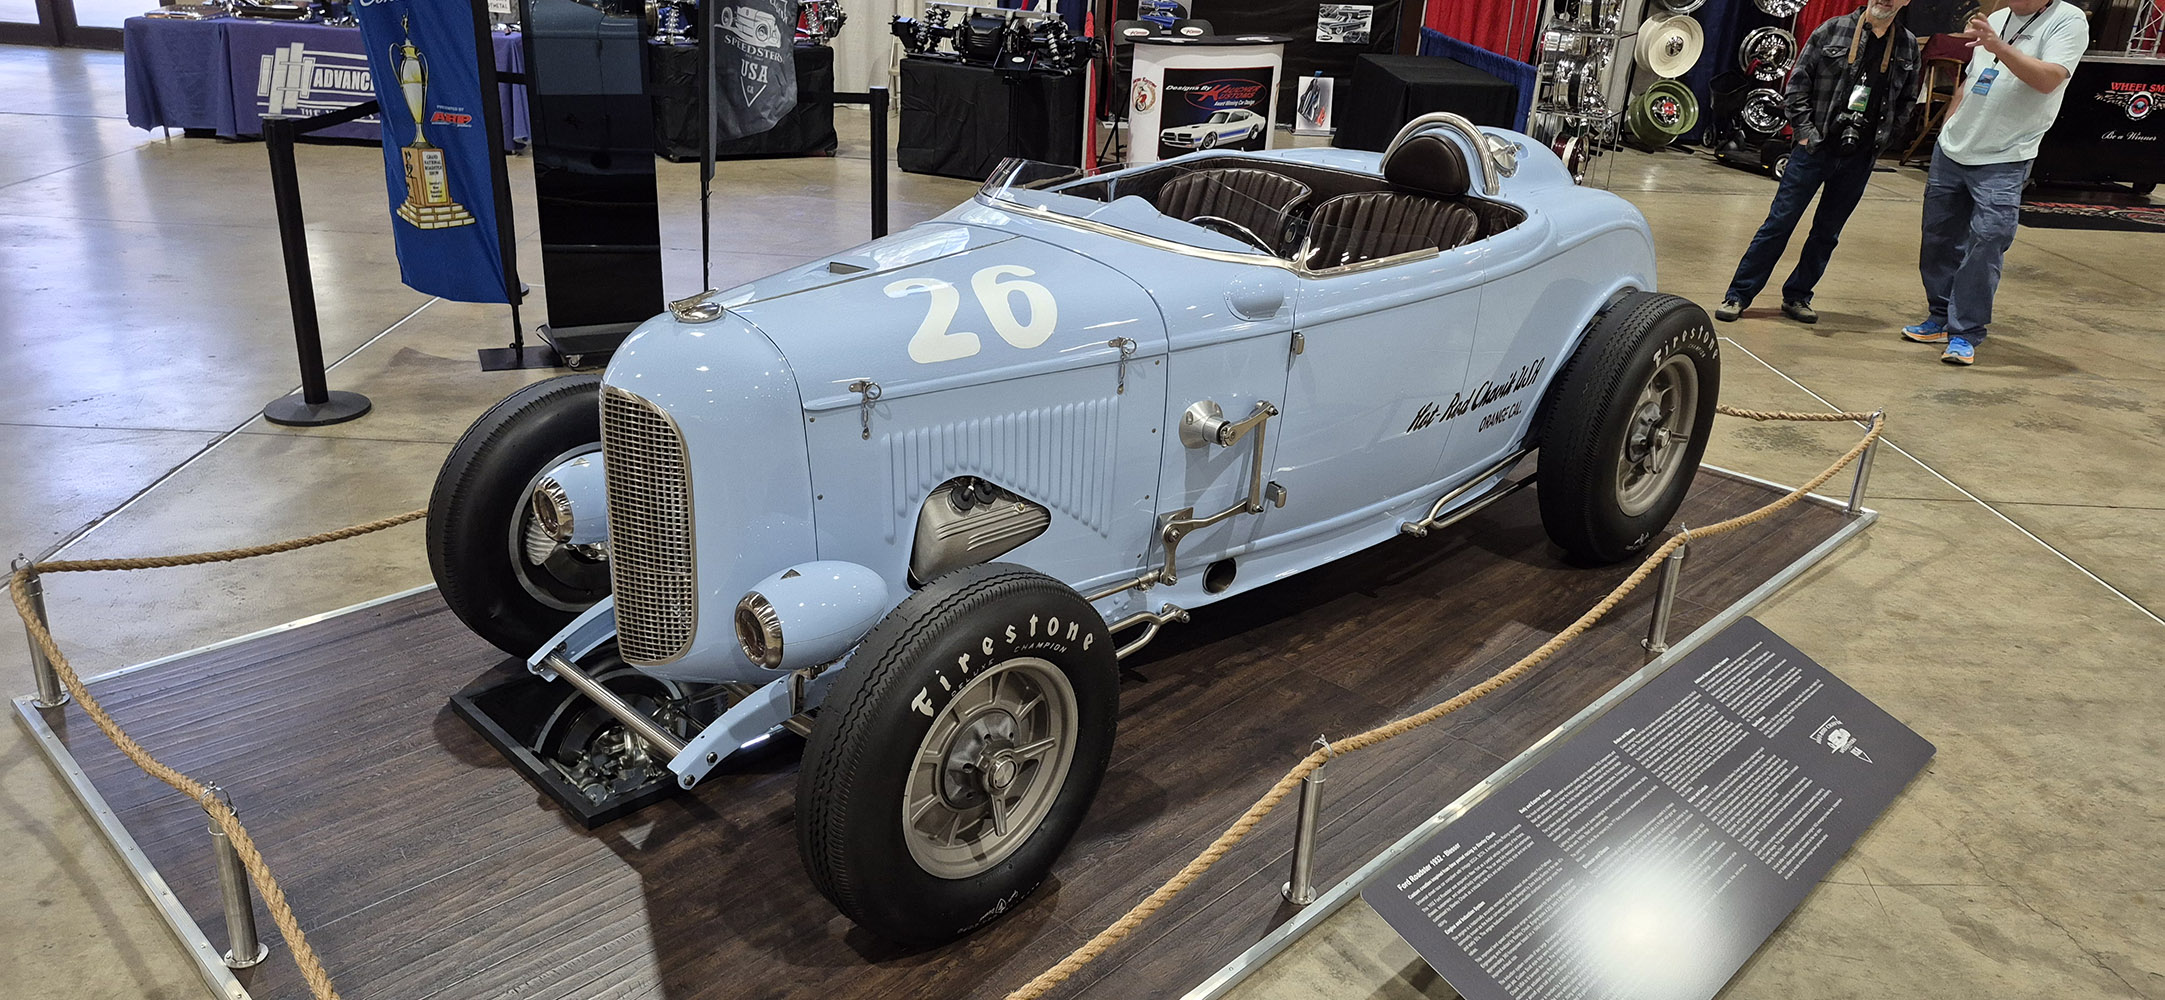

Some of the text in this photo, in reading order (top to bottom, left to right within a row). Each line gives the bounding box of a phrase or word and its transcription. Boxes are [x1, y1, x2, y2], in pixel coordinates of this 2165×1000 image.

[740, 59, 768, 84] USA
[746, 85, 754, 94] CA
[2111, 82, 2147, 91] WHEEL
[431, 112, 473, 124] ARP
[2101, 130, 2117, 140] Be
[2126, 131, 2157, 141] Winner
[884, 265, 1058, 364] 26
[1653, 325, 1719, 368] Firestone
[1513, 356, 1546, 392] USA
[1478, 406, 1509, 432] ORANGE
[1013, 640, 1068, 654] CHAMPION
[910, 613, 1096, 718] Firestone
[1396, 878, 1411, 890] Ford
[1408, 863, 1432, 882] Roadster
[1429, 855, 1443, 866] 1932
